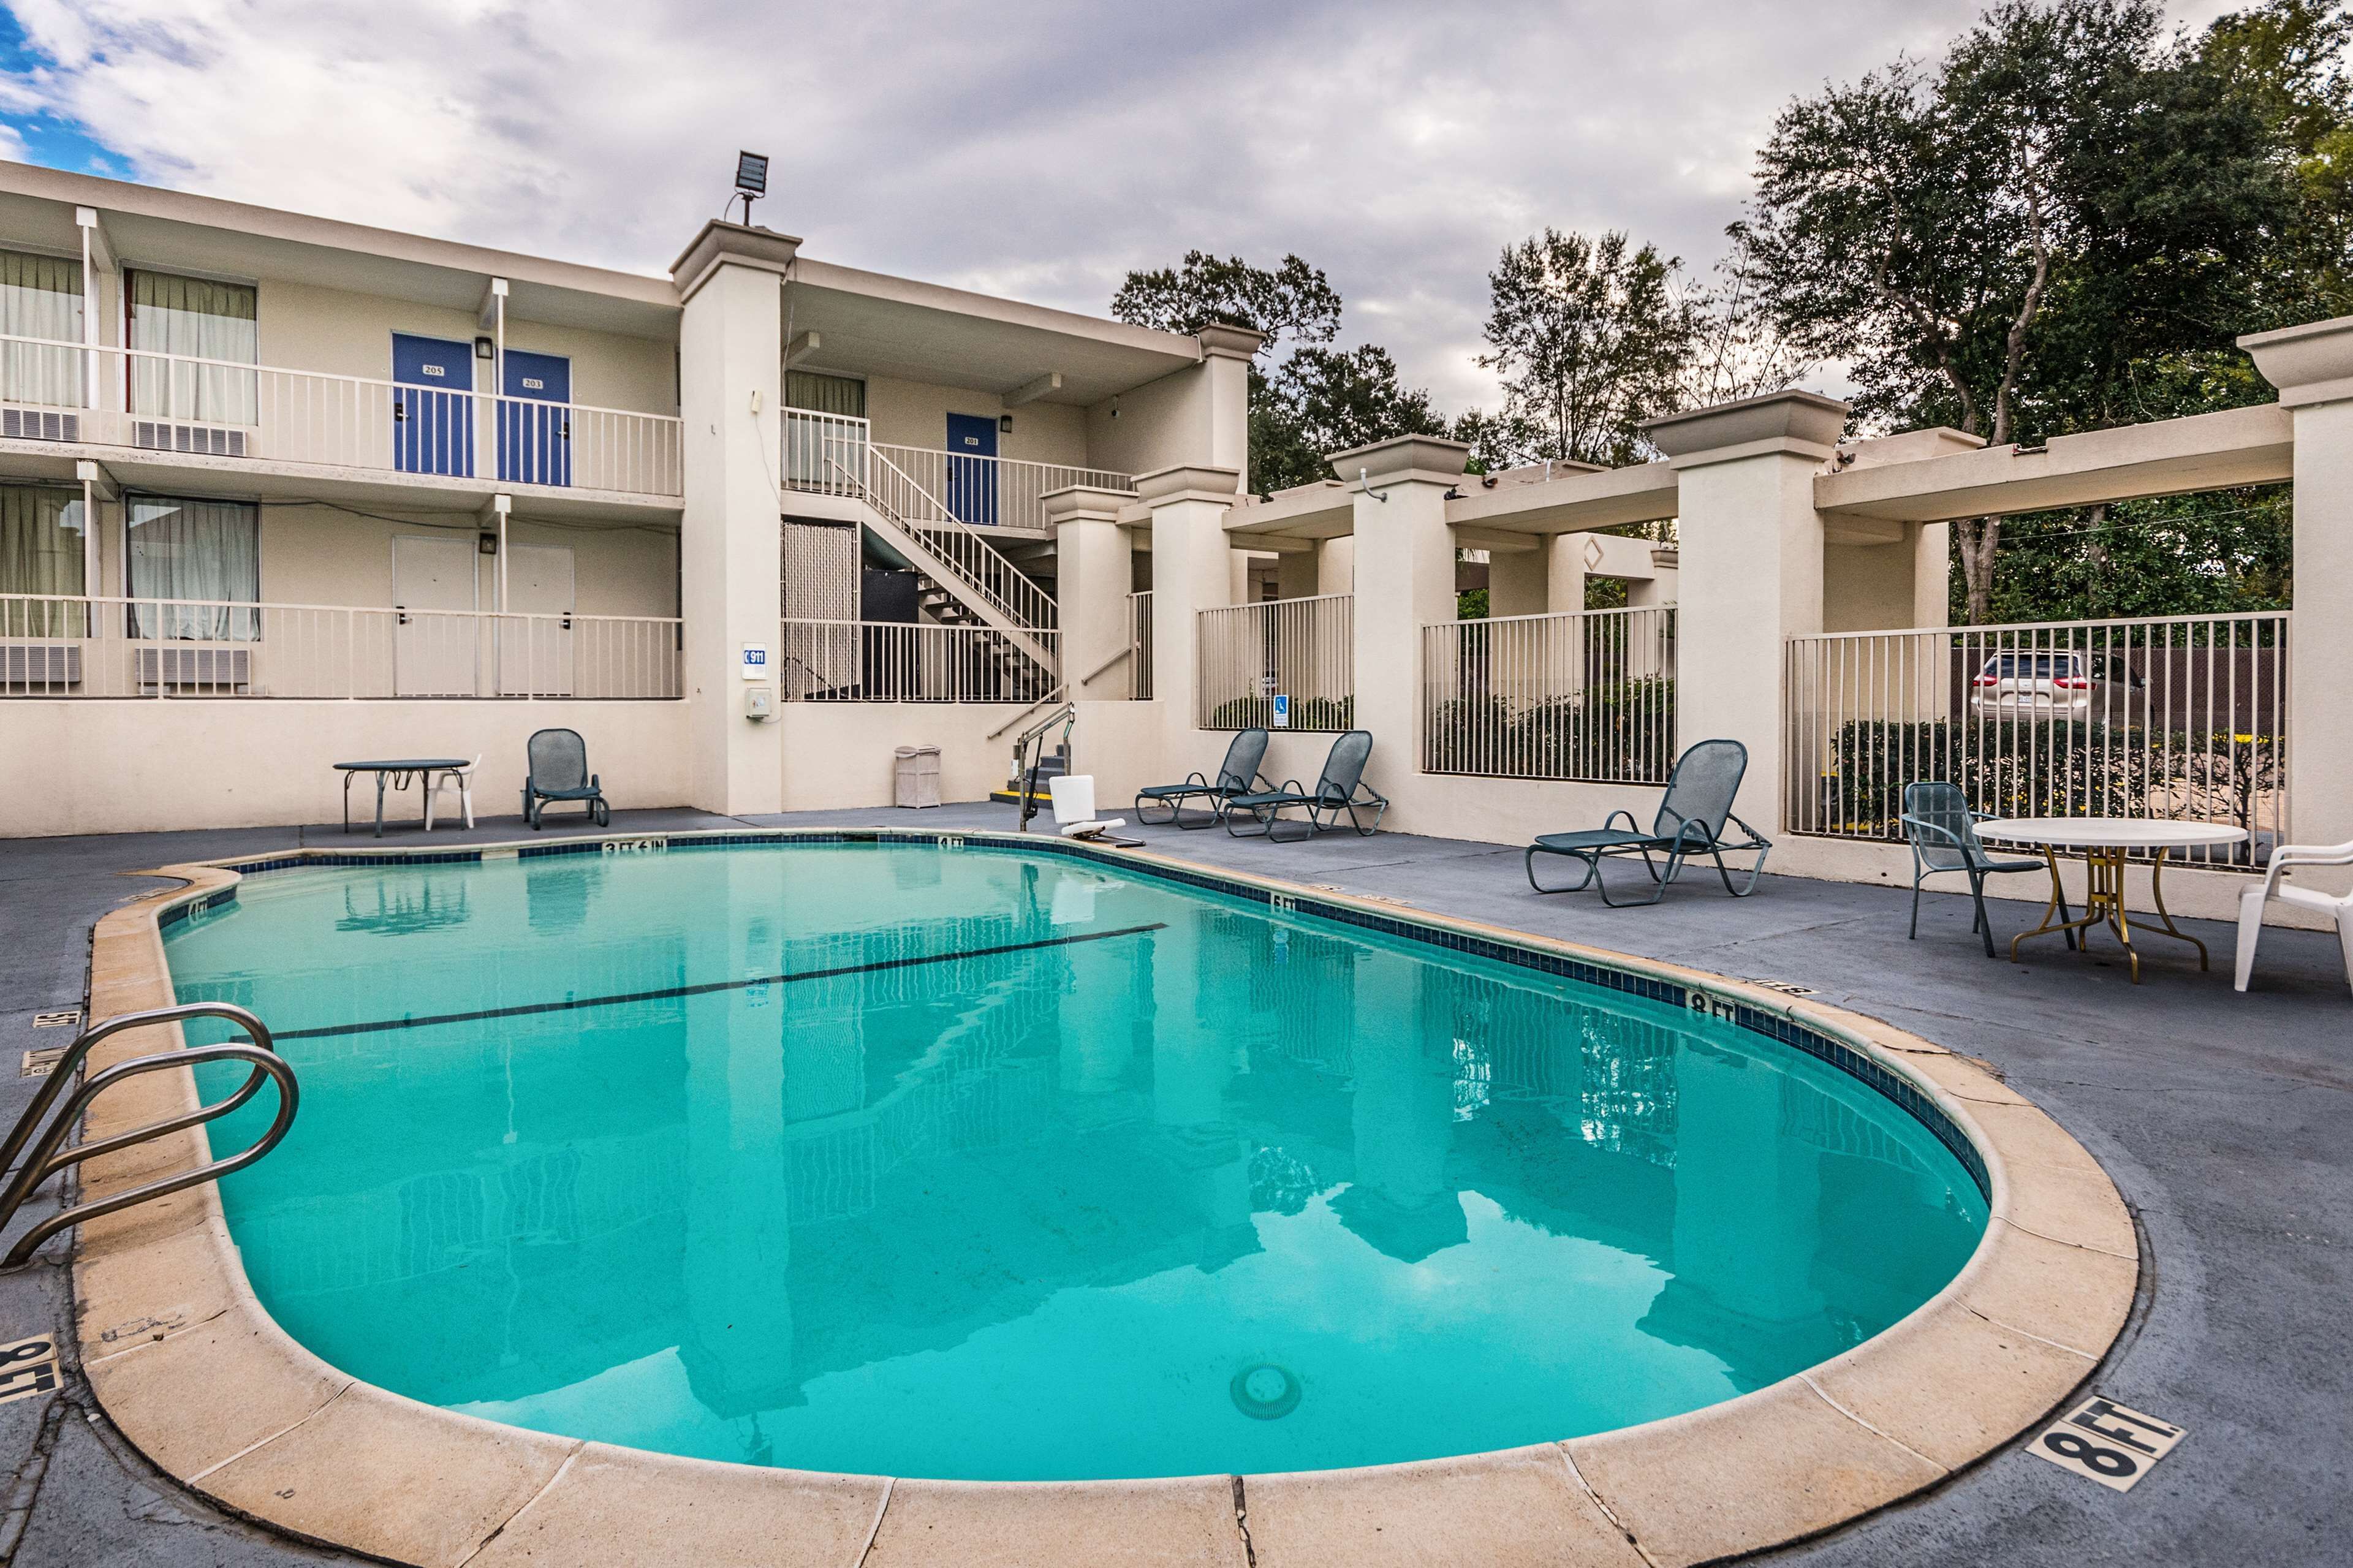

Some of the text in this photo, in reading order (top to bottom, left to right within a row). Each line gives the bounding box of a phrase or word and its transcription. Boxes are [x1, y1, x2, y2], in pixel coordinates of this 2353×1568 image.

[425, 366, 442, 375] 205
[525, 379, 541, 388] 203
[749, 651, 764, 664] 911
[2044, 1432, 2137, 1477] 8
